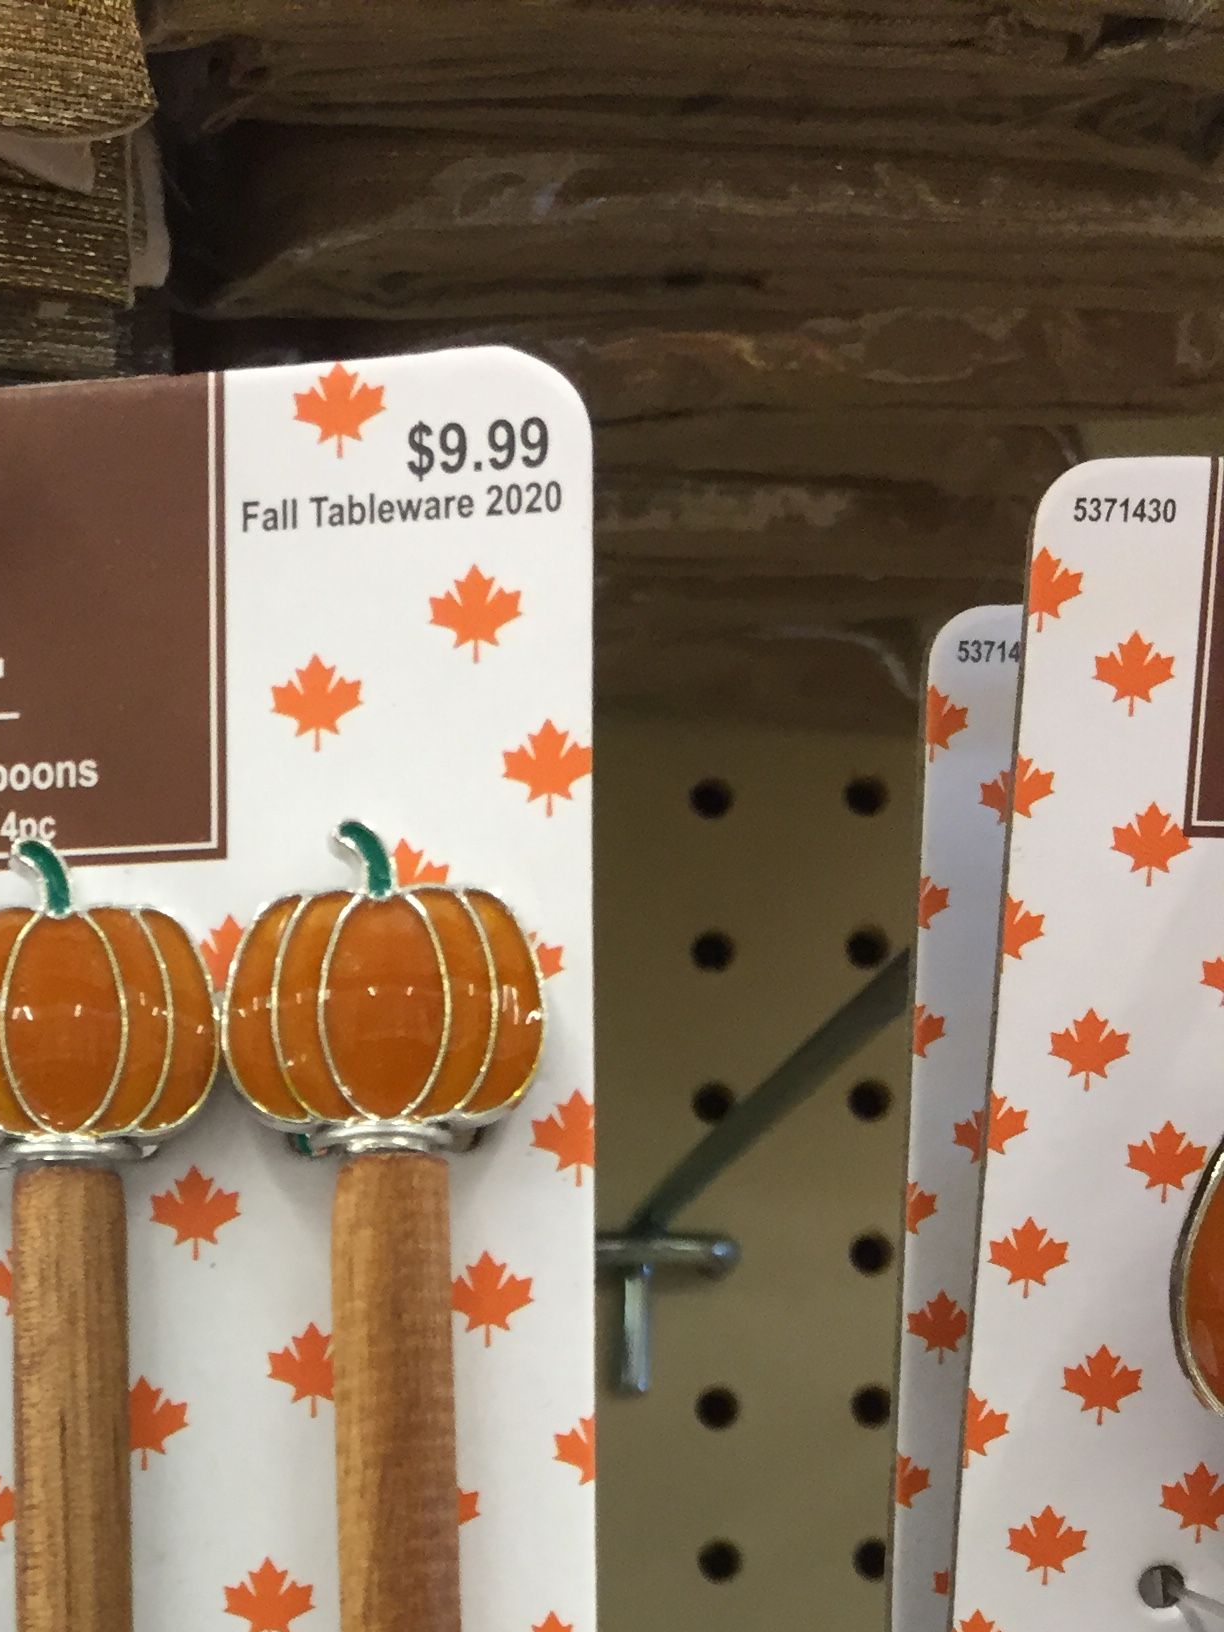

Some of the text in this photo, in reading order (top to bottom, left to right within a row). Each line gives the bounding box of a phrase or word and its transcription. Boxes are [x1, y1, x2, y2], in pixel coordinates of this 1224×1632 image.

[407, 416, 549, 481] $9.99
[242, 481, 562, 532] Fall Tableware 2020
[1074, 498, 1177, 524] 5371430
